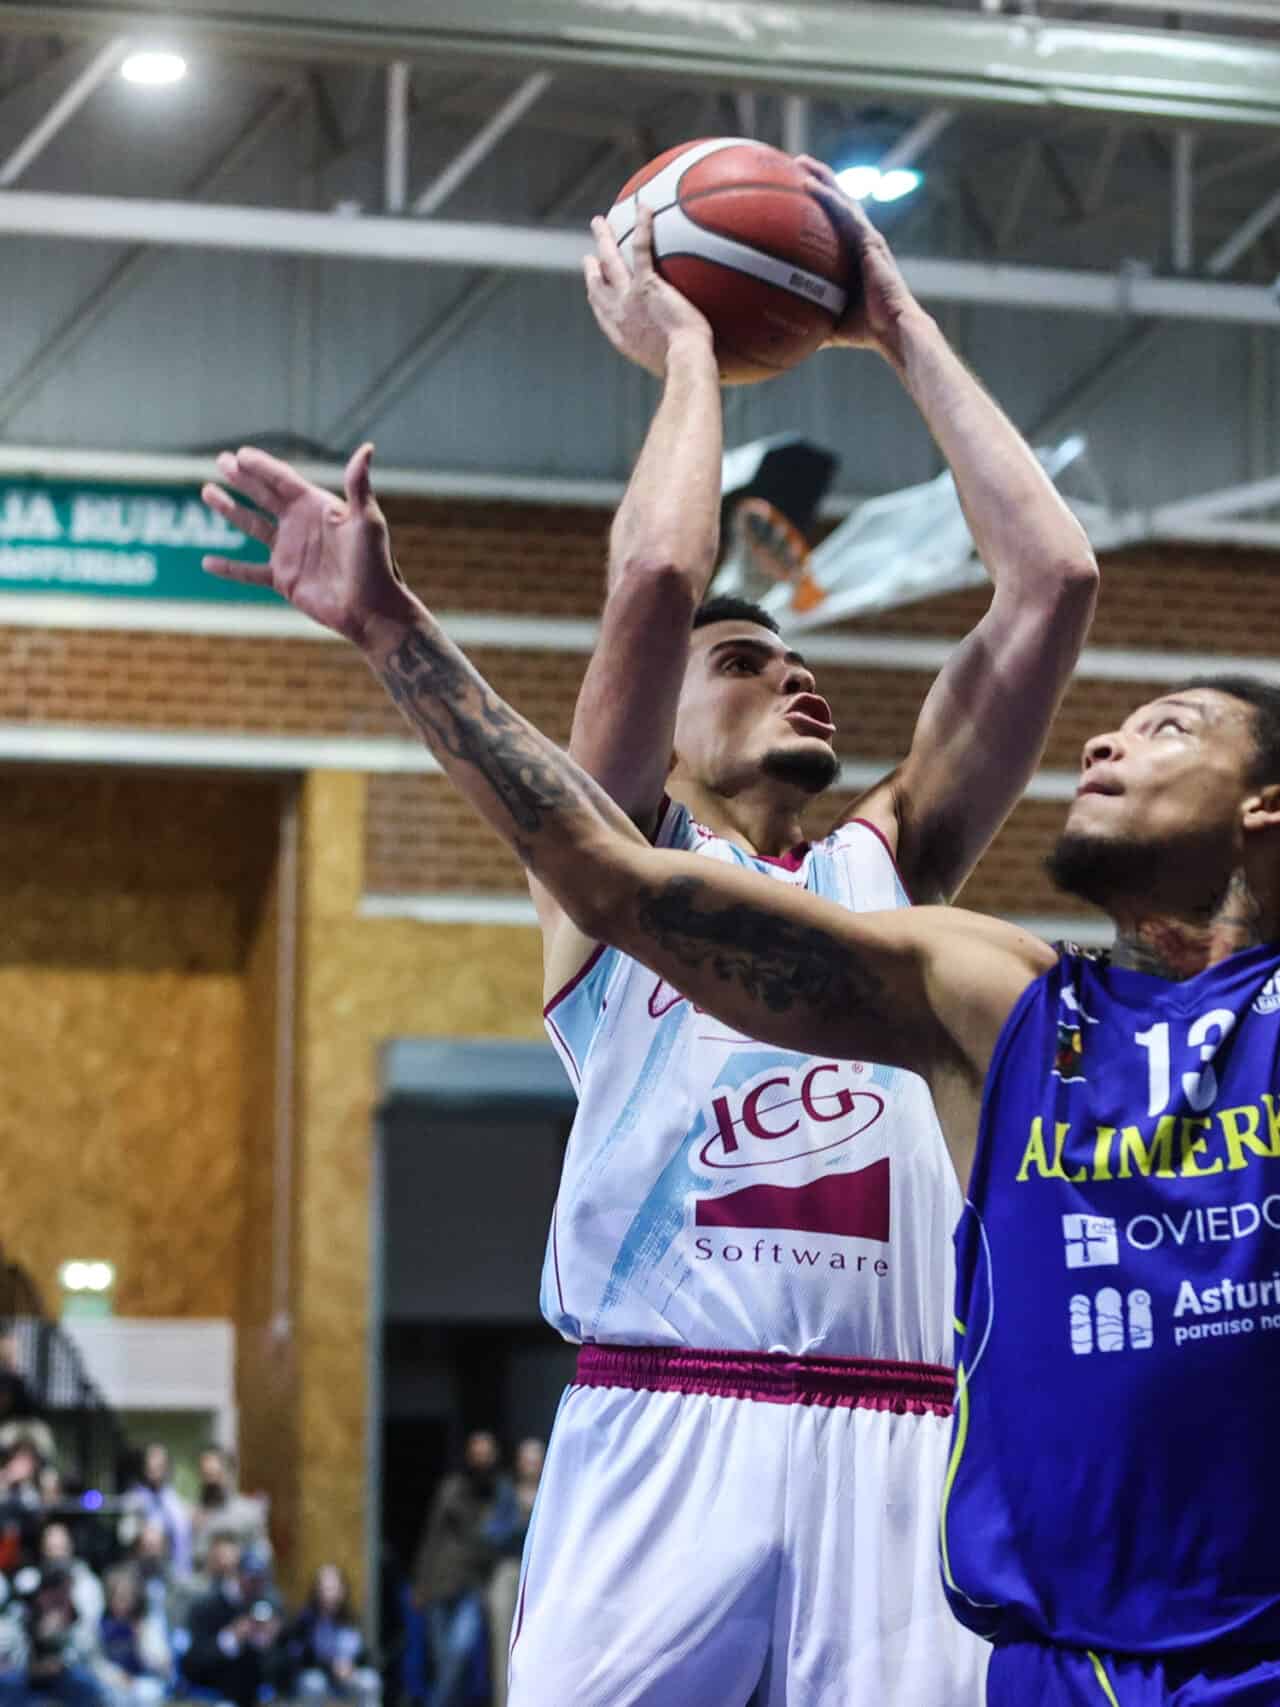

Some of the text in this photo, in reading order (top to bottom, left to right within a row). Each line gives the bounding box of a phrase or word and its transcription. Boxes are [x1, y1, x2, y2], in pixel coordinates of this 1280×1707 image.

[70, 493, 247, 550] RURAL
[1135, 1008, 1236, 1117] 13
[694, 1237, 890, 1277] Software
